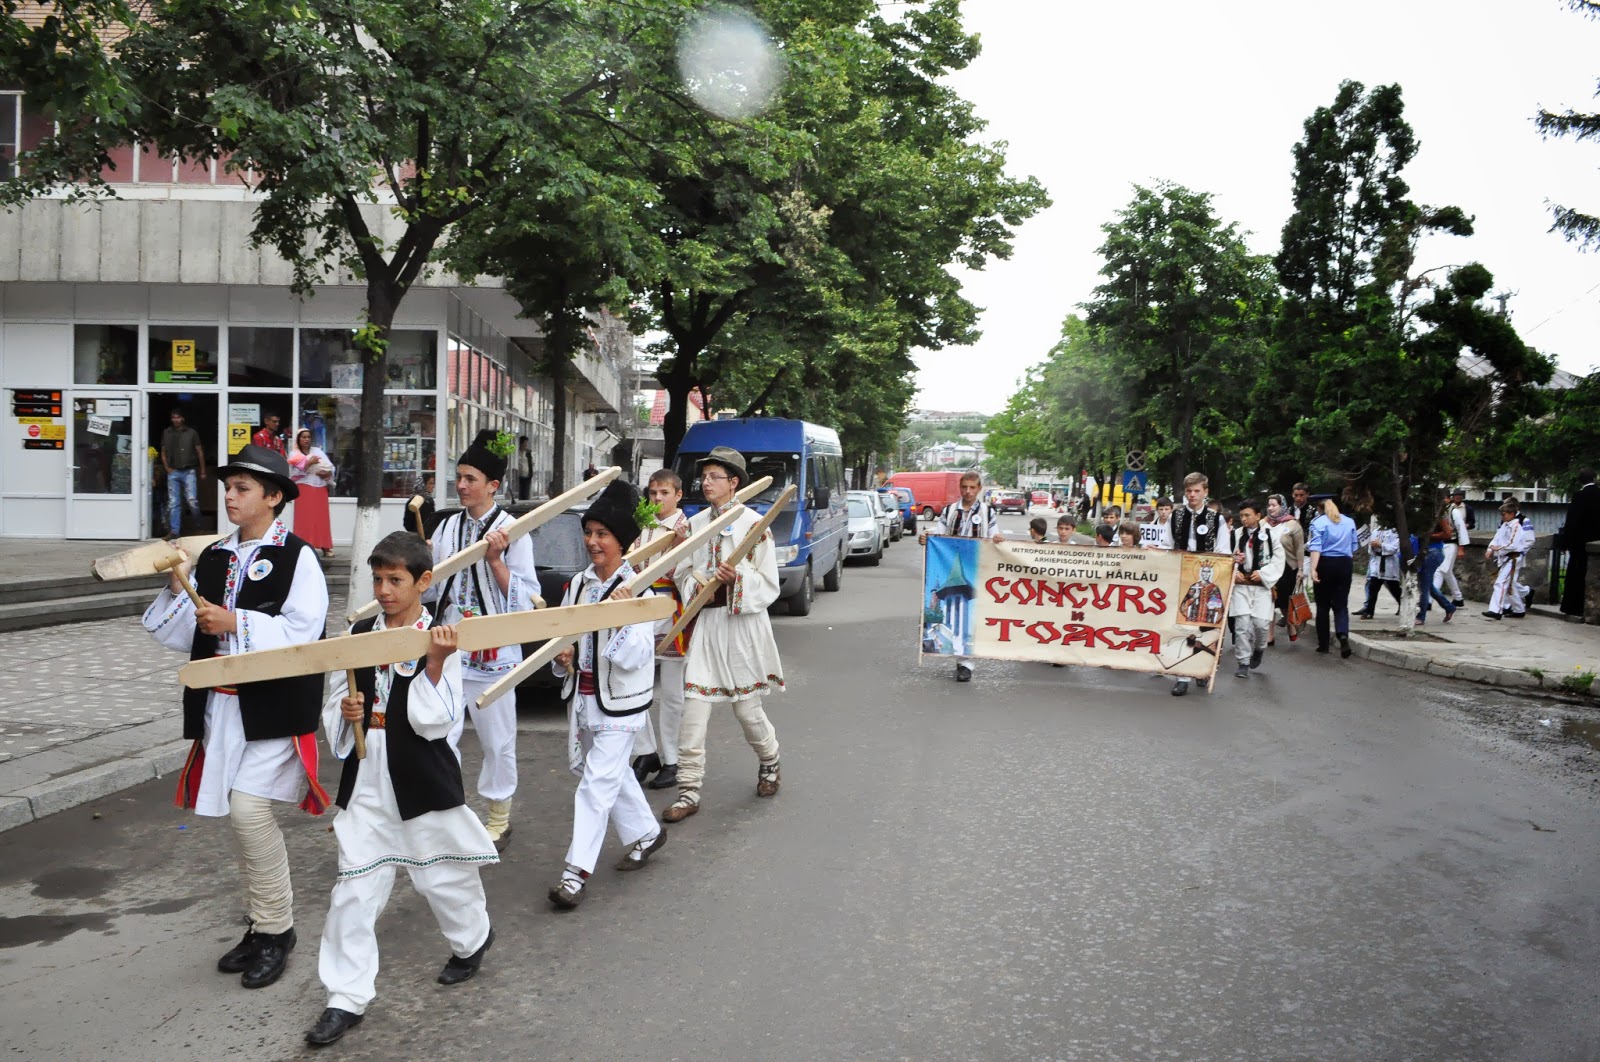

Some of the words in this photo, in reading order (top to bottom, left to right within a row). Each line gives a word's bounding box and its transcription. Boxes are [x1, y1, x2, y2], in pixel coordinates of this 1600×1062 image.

[1011, 547, 1056, 556] MITROPOLIA
[1057, 550, 1095, 558] MOLDOVEI
[1106, 553, 1147, 561] BUCOVINEI
[1034, 557, 1090, 566] ARHIEPISCOPIA
[997, 562, 1102, 580] PROTOPOPIATUL
[1106, 568, 1159, 583] HÂRLĂU
[985, 617, 1161, 655] TOACA
